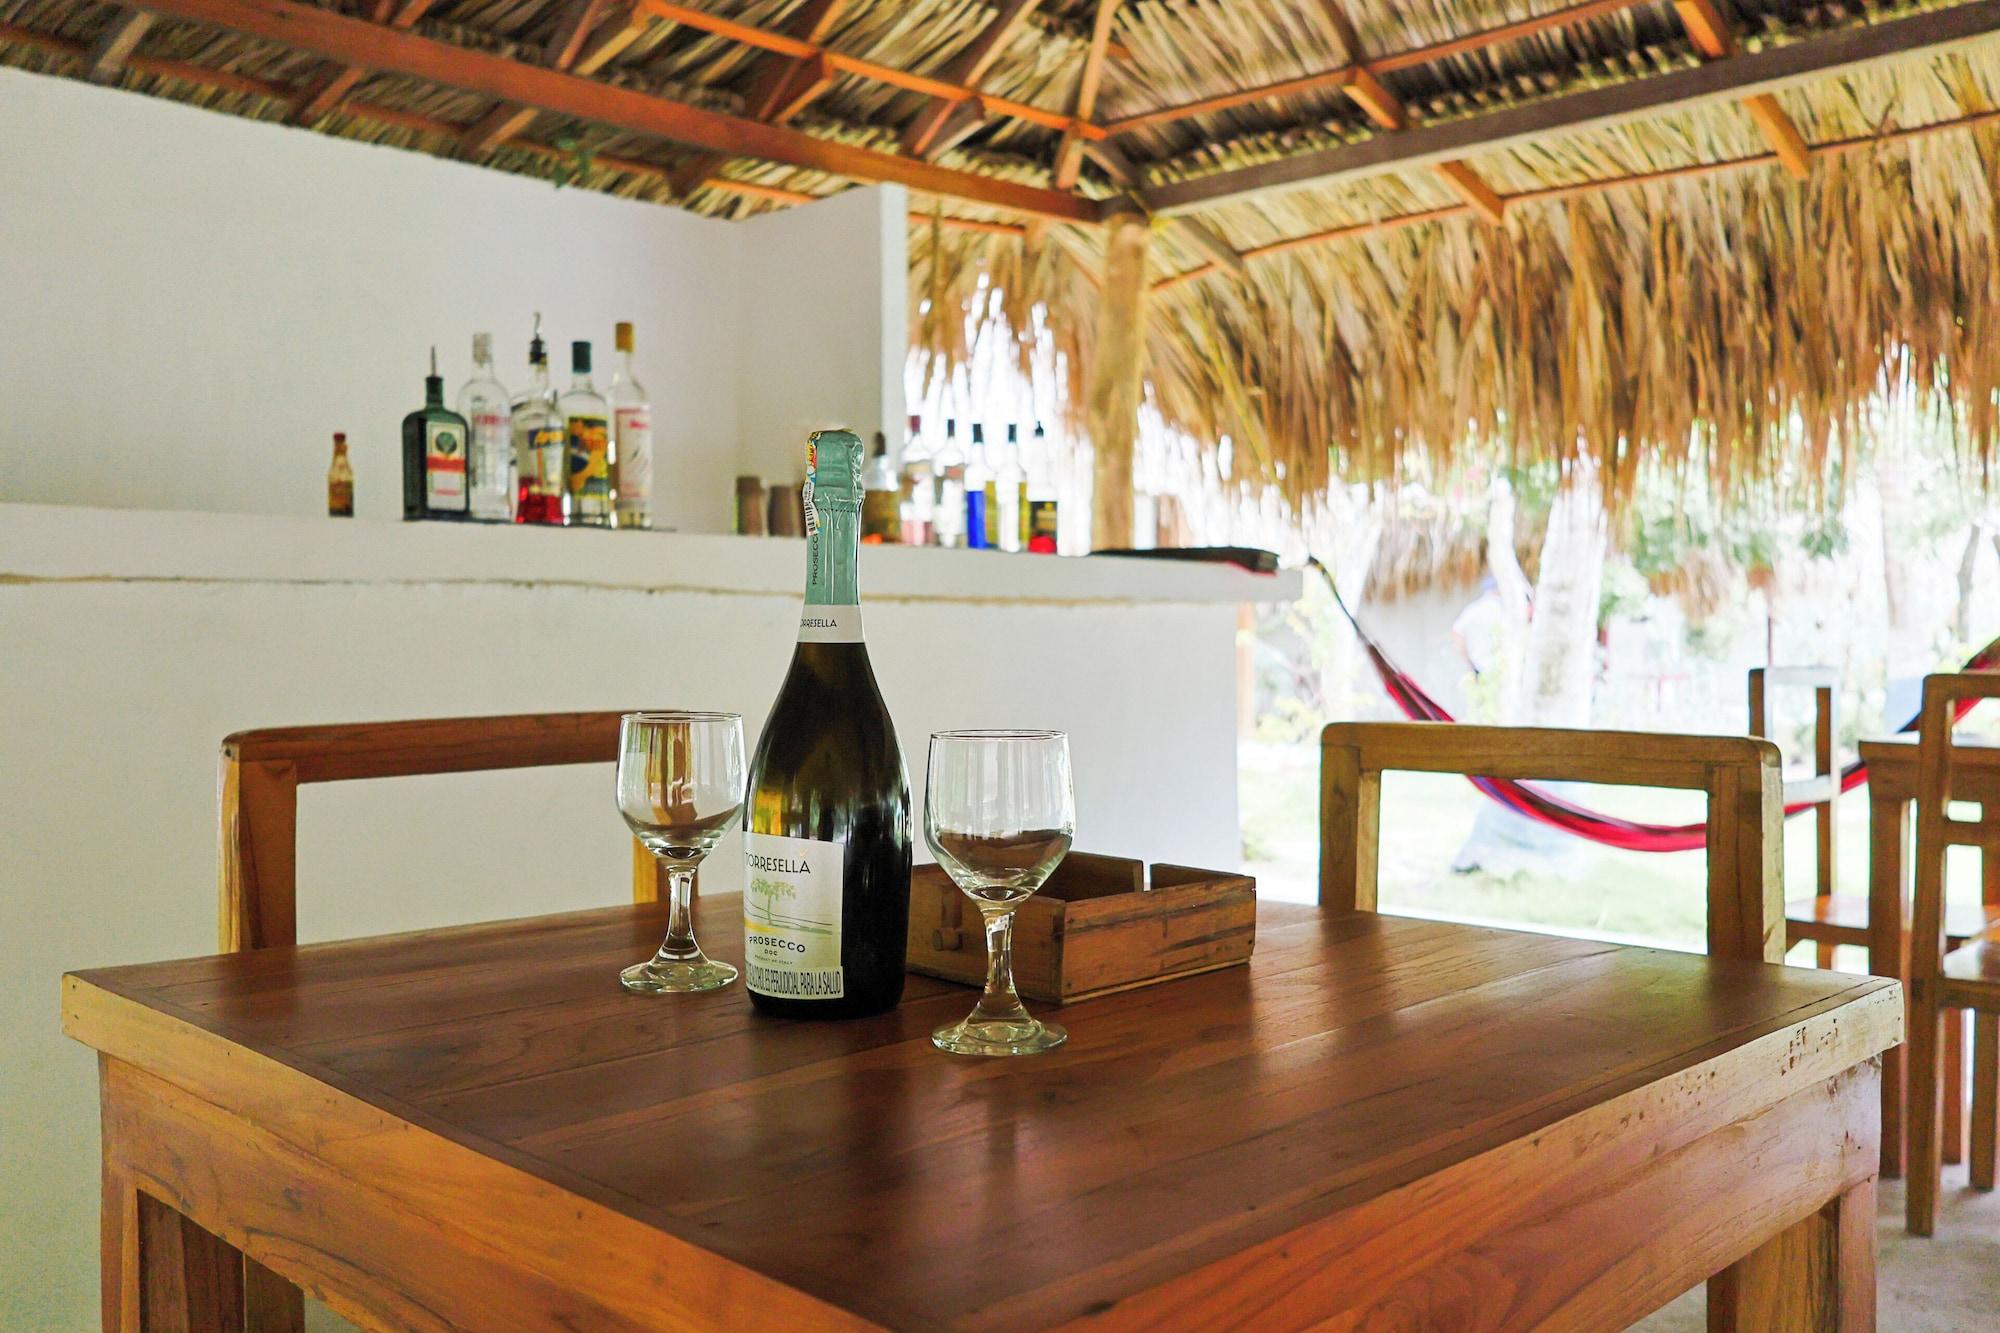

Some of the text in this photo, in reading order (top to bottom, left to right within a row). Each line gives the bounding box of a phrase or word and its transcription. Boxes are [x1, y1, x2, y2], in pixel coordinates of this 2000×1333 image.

[749, 936, 806, 953] PROSECCO
[800, 971, 814, 995] PARA
[822, 971, 840, 995] SALUD
